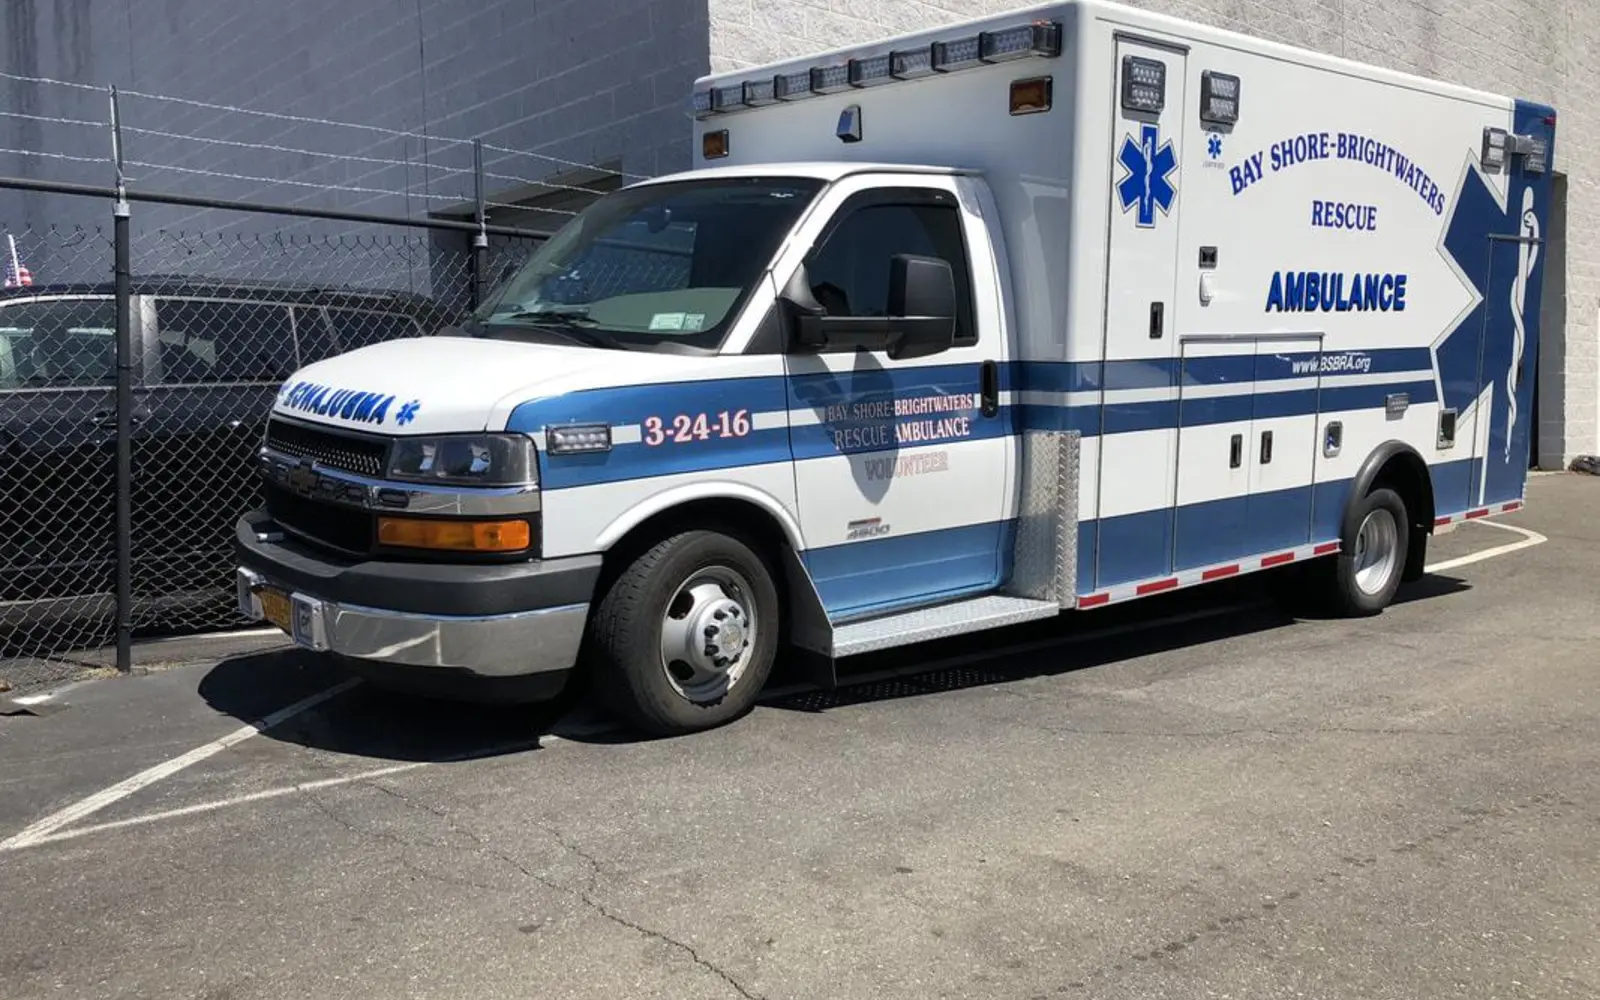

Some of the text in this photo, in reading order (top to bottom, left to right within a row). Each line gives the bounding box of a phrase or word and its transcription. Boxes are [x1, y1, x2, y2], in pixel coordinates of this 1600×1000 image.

[1229, 132, 1446, 216] BAY SHORE-BRIGHTWATERS
[1311, 200, 1377, 231] RESCUE
[1265, 270, 1407, 313] AMBULANCE
[1291, 355, 1372, 374] www.BSBRA.org
[827, 393, 974, 422] BAY SHORE-BRIGHTWATERS
[644, 408, 750, 447] 3-24-16
[834, 416, 971, 450] RESCUE AMBULANCE
[864, 451, 949, 481] VOLUNTEER
